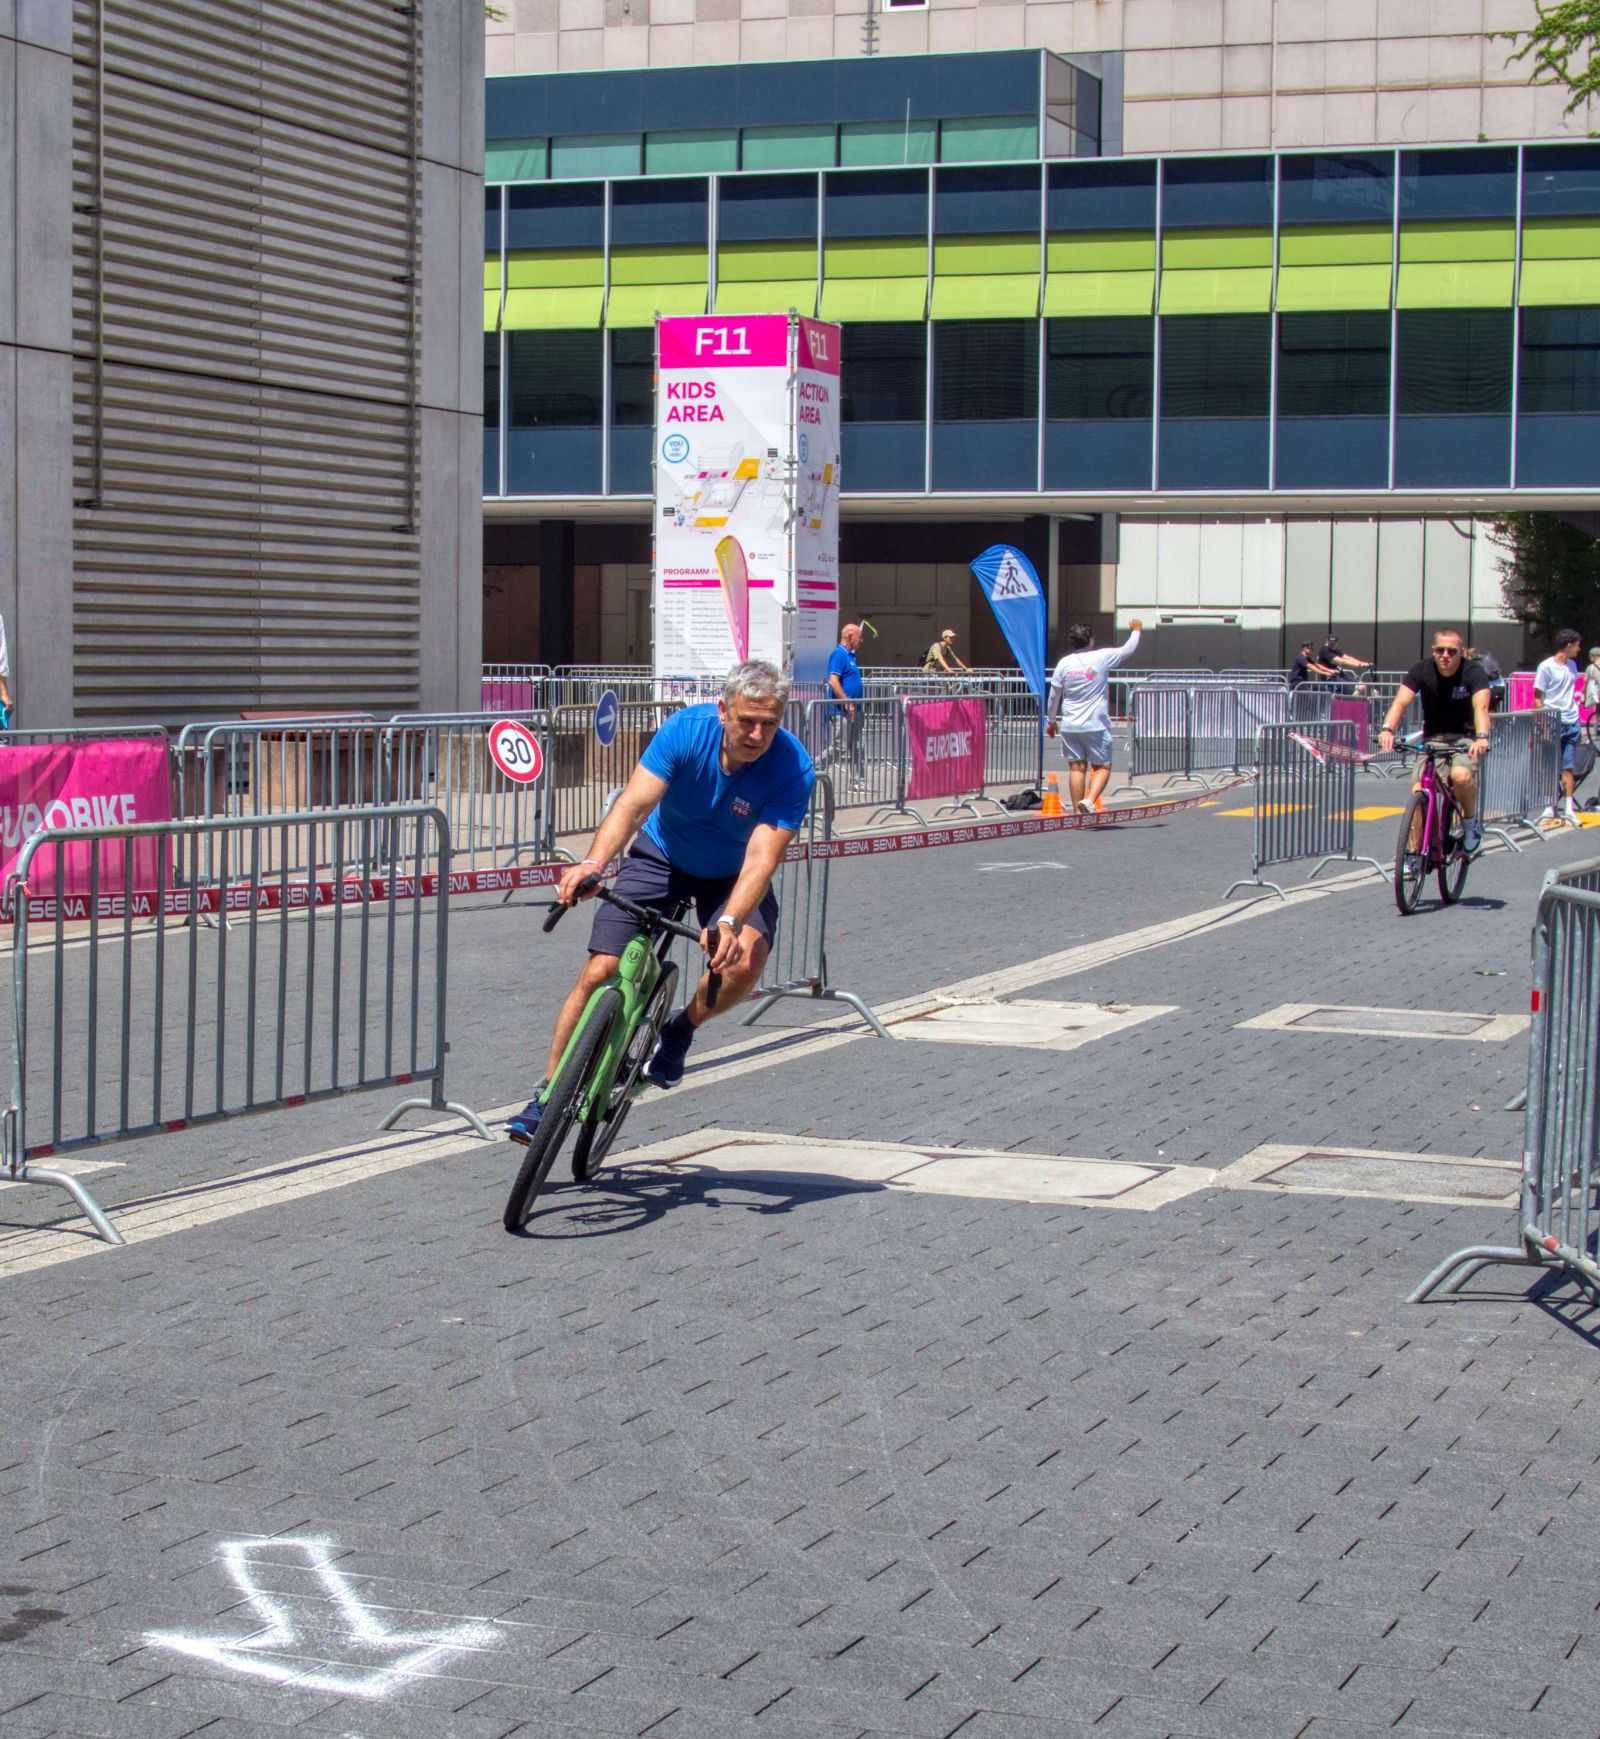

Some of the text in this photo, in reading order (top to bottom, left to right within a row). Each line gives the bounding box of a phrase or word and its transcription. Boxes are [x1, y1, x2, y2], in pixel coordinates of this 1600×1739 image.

[695, 326, 751, 356] F11
[809, 329, 828, 361] F11
[667, 382, 716, 399] KIDS
[799, 382, 829, 403] ACTION
[666, 405, 724, 423] AREA
[799, 405, 821, 425] AREA
[501, 738, 531, 764] 30
[0, 794, 137, 848] UROBIKE
[844, 841, 869, 854] SENA
[873, 838, 898, 852] SENA
[901, 835, 924, 849] SENA
[927, 832, 950, 845] SENA
[952, 829, 974, 842] SENA
[977, 827, 998, 839] SENA
[1001, 824, 1020, 836] SENA
[1023, 821, 1041, 833] SENA
[1044, 819, 1060, 831] SENA
[29, 899, 86, 919] SENA
[98, 896, 151, 915] SENA
[383, 880, 424, 898] SEN
[476, 872, 513, 889] SENA
[520, 868, 554, 885] SENA
